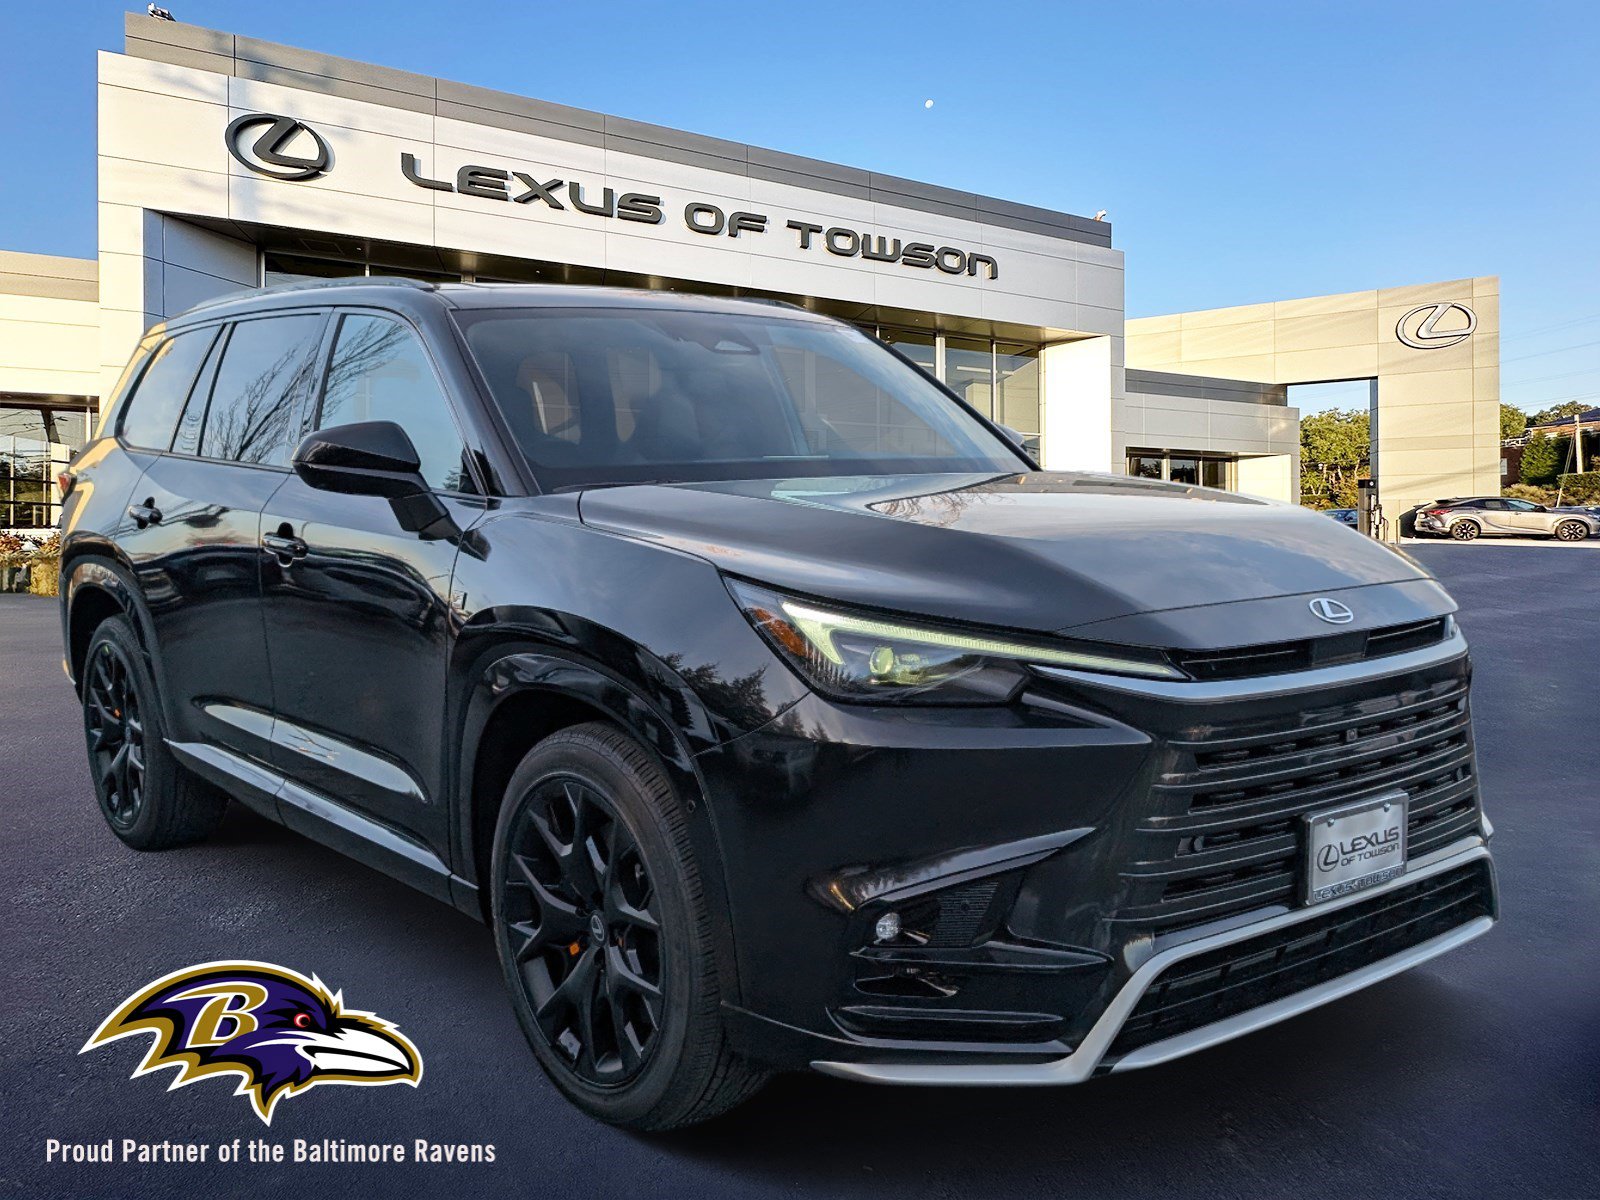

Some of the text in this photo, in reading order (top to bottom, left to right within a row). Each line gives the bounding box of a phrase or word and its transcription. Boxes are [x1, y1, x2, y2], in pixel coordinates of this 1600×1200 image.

[401, 152, 998, 280] LEXUS OF TOWSON
[1340, 826, 1399, 855] LEXUS
[1341, 842, 1400, 866] OF TOWSON
